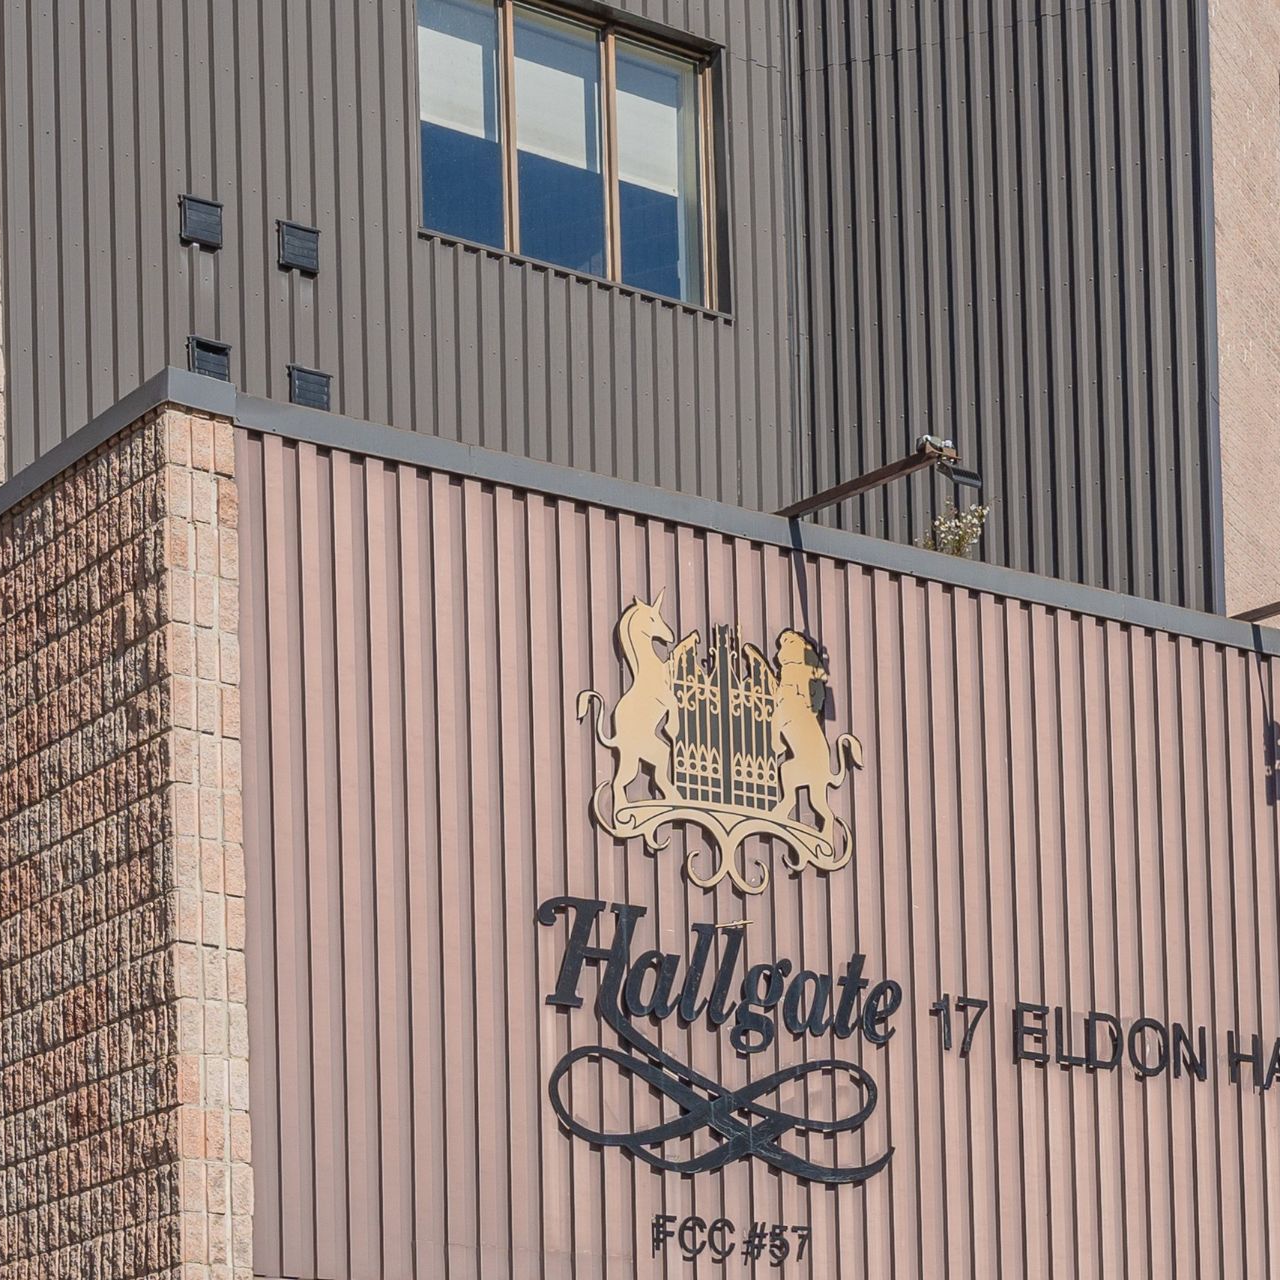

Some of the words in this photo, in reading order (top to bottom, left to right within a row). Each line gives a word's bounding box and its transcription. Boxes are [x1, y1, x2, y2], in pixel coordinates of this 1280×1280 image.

[538, 895, 903, 1054] Hallgate
[930, 993, 988, 1056] 17
[1013, 1001, 1208, 1083] ELDON
[652, 1213, 736, 1264] FCC
[741, 1219, 812, 1266] #57
